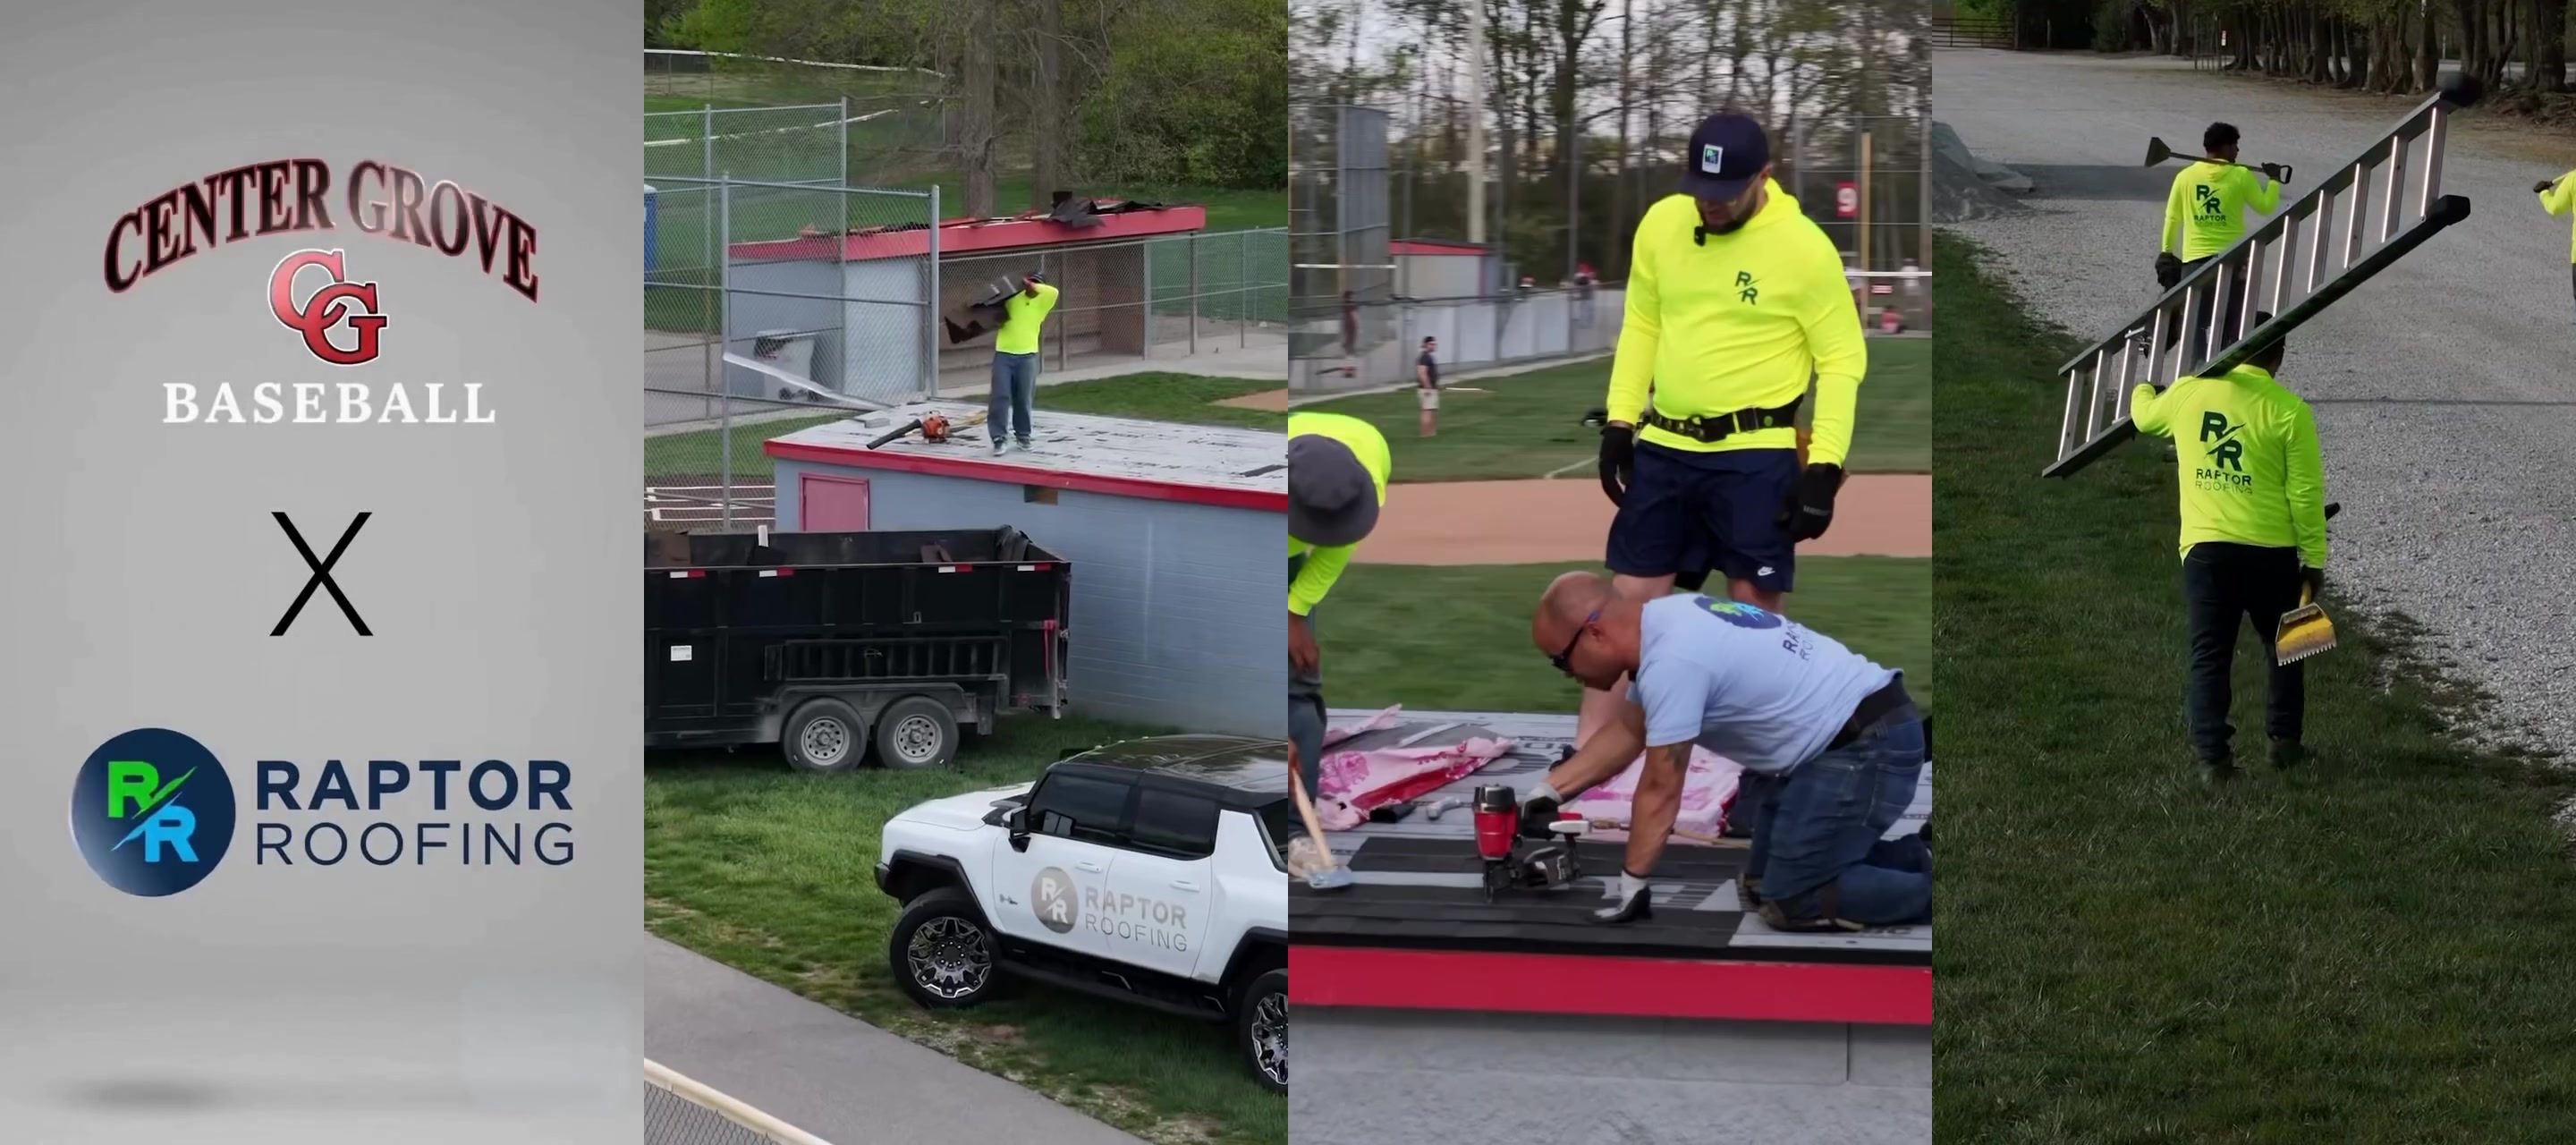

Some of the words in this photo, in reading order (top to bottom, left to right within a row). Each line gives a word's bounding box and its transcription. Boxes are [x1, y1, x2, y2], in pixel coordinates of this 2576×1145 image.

[1838, 188, 1858, 212] 9
[2196, 469, 2251, 486] RAPTOR
[1085, 885, 1187, 929] RAPTOR
[1085, 912, 1188, 953] ROOFING
